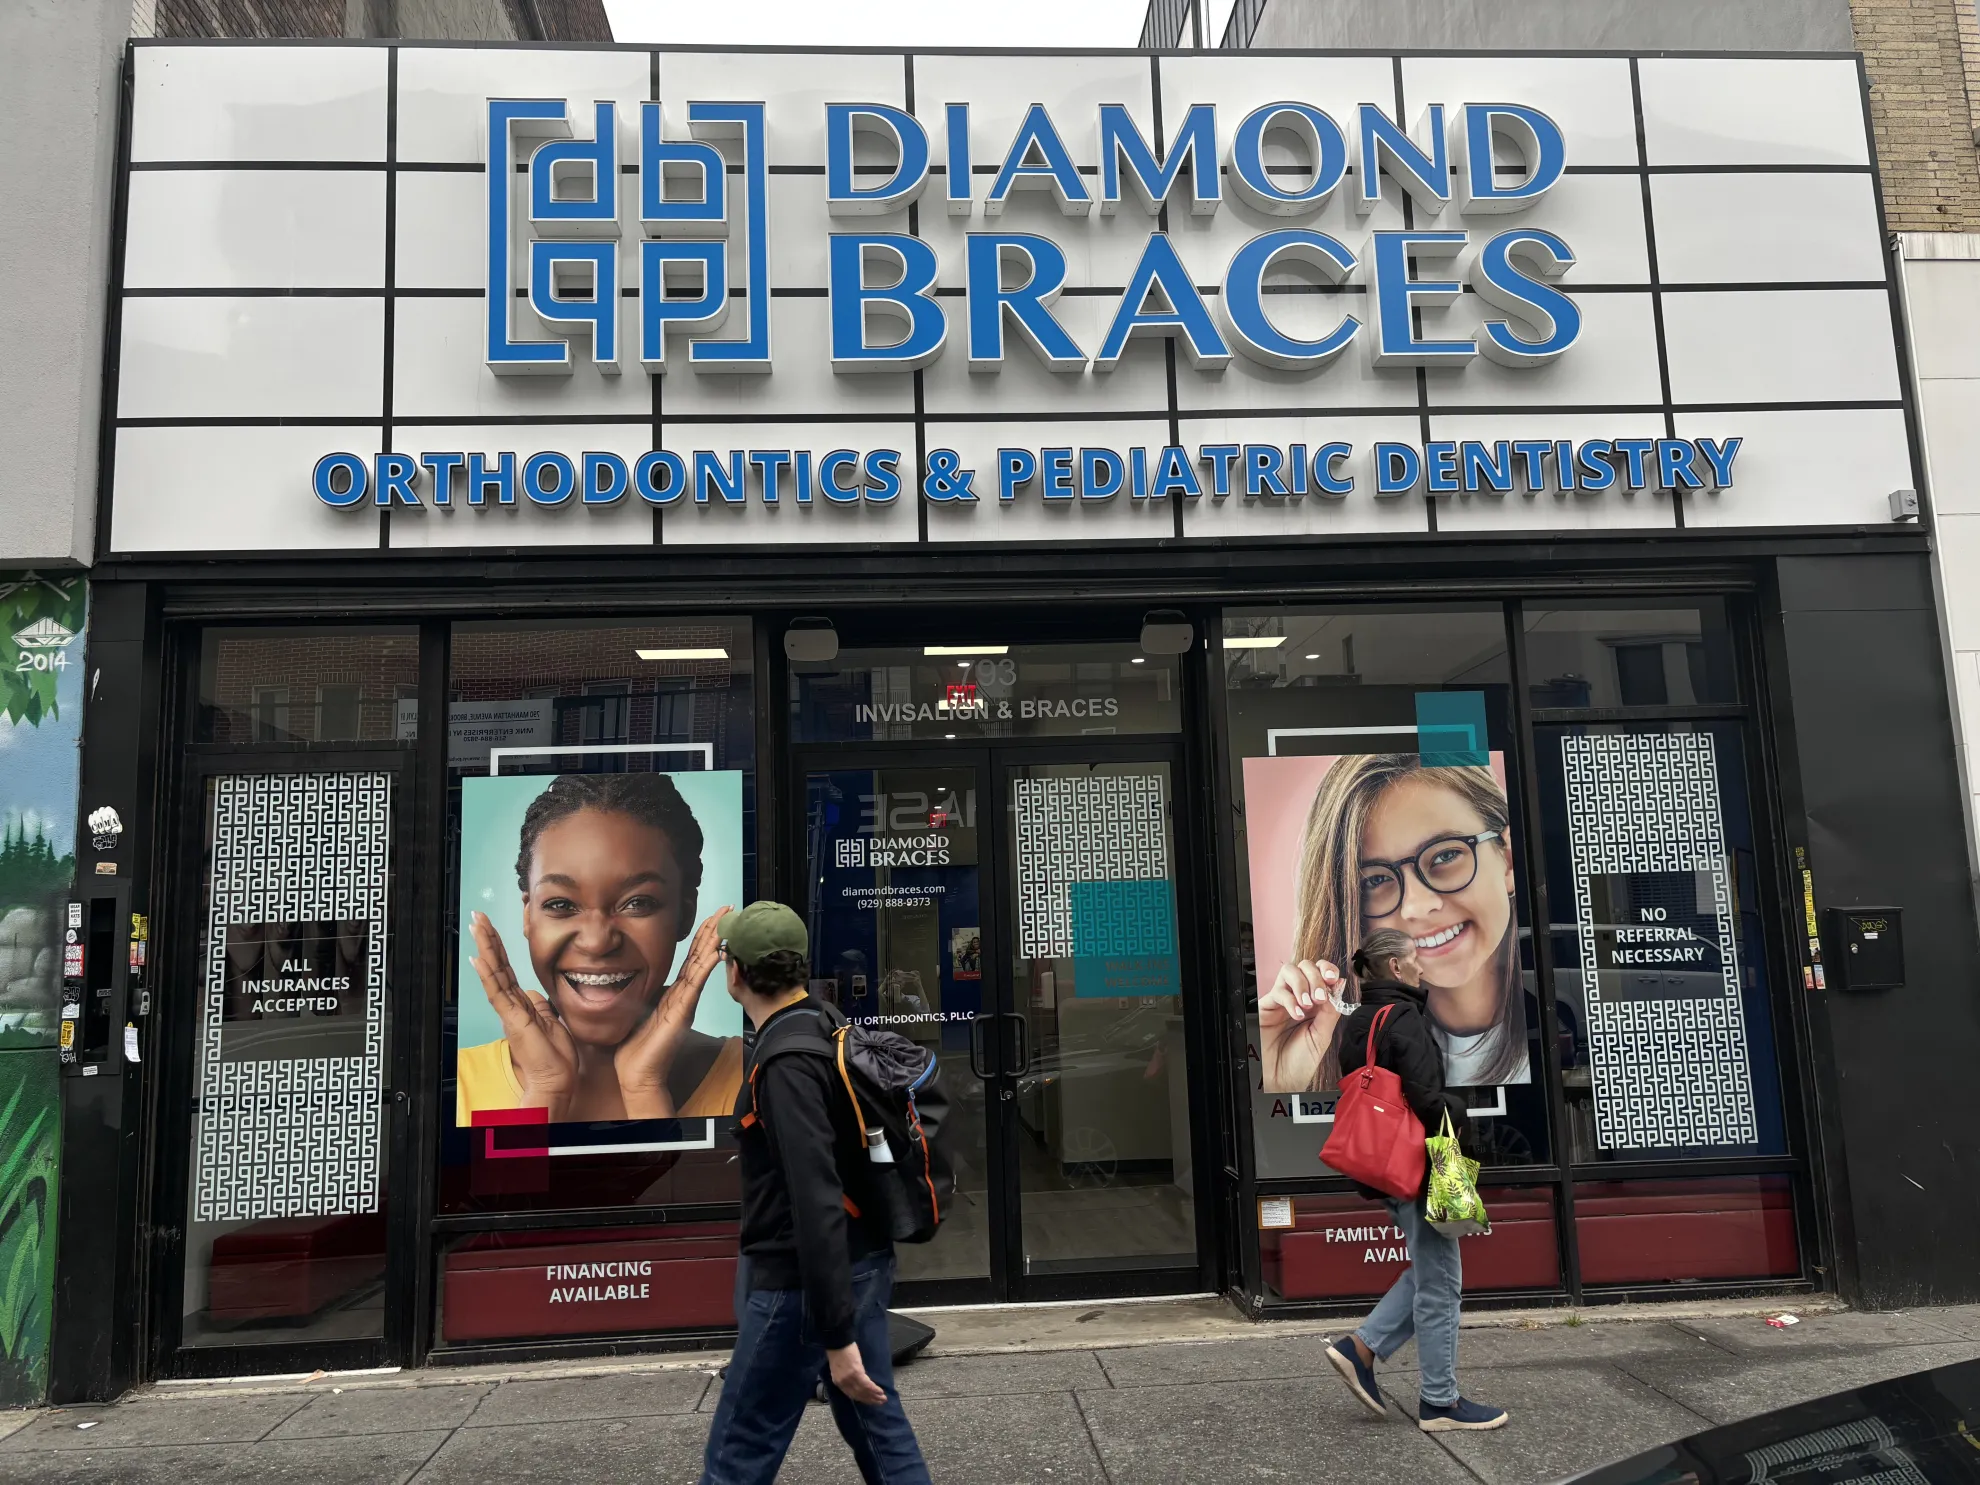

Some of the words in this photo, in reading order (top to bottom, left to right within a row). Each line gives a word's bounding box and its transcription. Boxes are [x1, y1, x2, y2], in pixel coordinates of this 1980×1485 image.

[824, 101, 1567, 208] DIAMOND
[828, 227, 1584, 364] BRACES
[312, 448, 902, 507] ORTHODONTICS
[922, 447, 980, 503] &
[997, 442, 1356, 502] PEDIATRIC
[1373, 437, 1743, 496] DENTISTRY
[16, 651, 73, 672] 2014
[956, 658, 1017, 687] 793
[855, 701, 989, 723] INVISALIGN
[996, 701, 1014, 719] &
[1020, 697, 1119, 719] BRACES
[91, 817, 117, 831] COMA
[869, 836, 950, 850] DIAMOND
[869, 849, 950, 867] BRACES
[842, 885, 946, 897] diamondbraces.com
[857, 899, 883, 910] (929)
[885, 897, 931, 907] 888-9373
[1640, 907, 1667, 922] NO
[1615, 927, 1698, 943] REFERRAL
[1611, 947, 1705, 964] NECESSARY
[281, 958, 312, 972] ALL
[242, 977, 350, 994] INSURANCES
[251, 997, 338, 1013] ACCEPTED
[854, 1016, 862, 1026] U
[863, 1013, 948, 1025] ORTHODONTICS,
[950, 1011, 975, 1021] PLLC
[1270, 1096, 1341, 1118] Amaz
[1325, 1225, 1389, 1243] FAMILY
[1363, 1247, 1412, 1263] AVAIL
[547, 1261, 652, 1280] FINANCING
[549, 1284, 650, 1303] AVAILABLE
